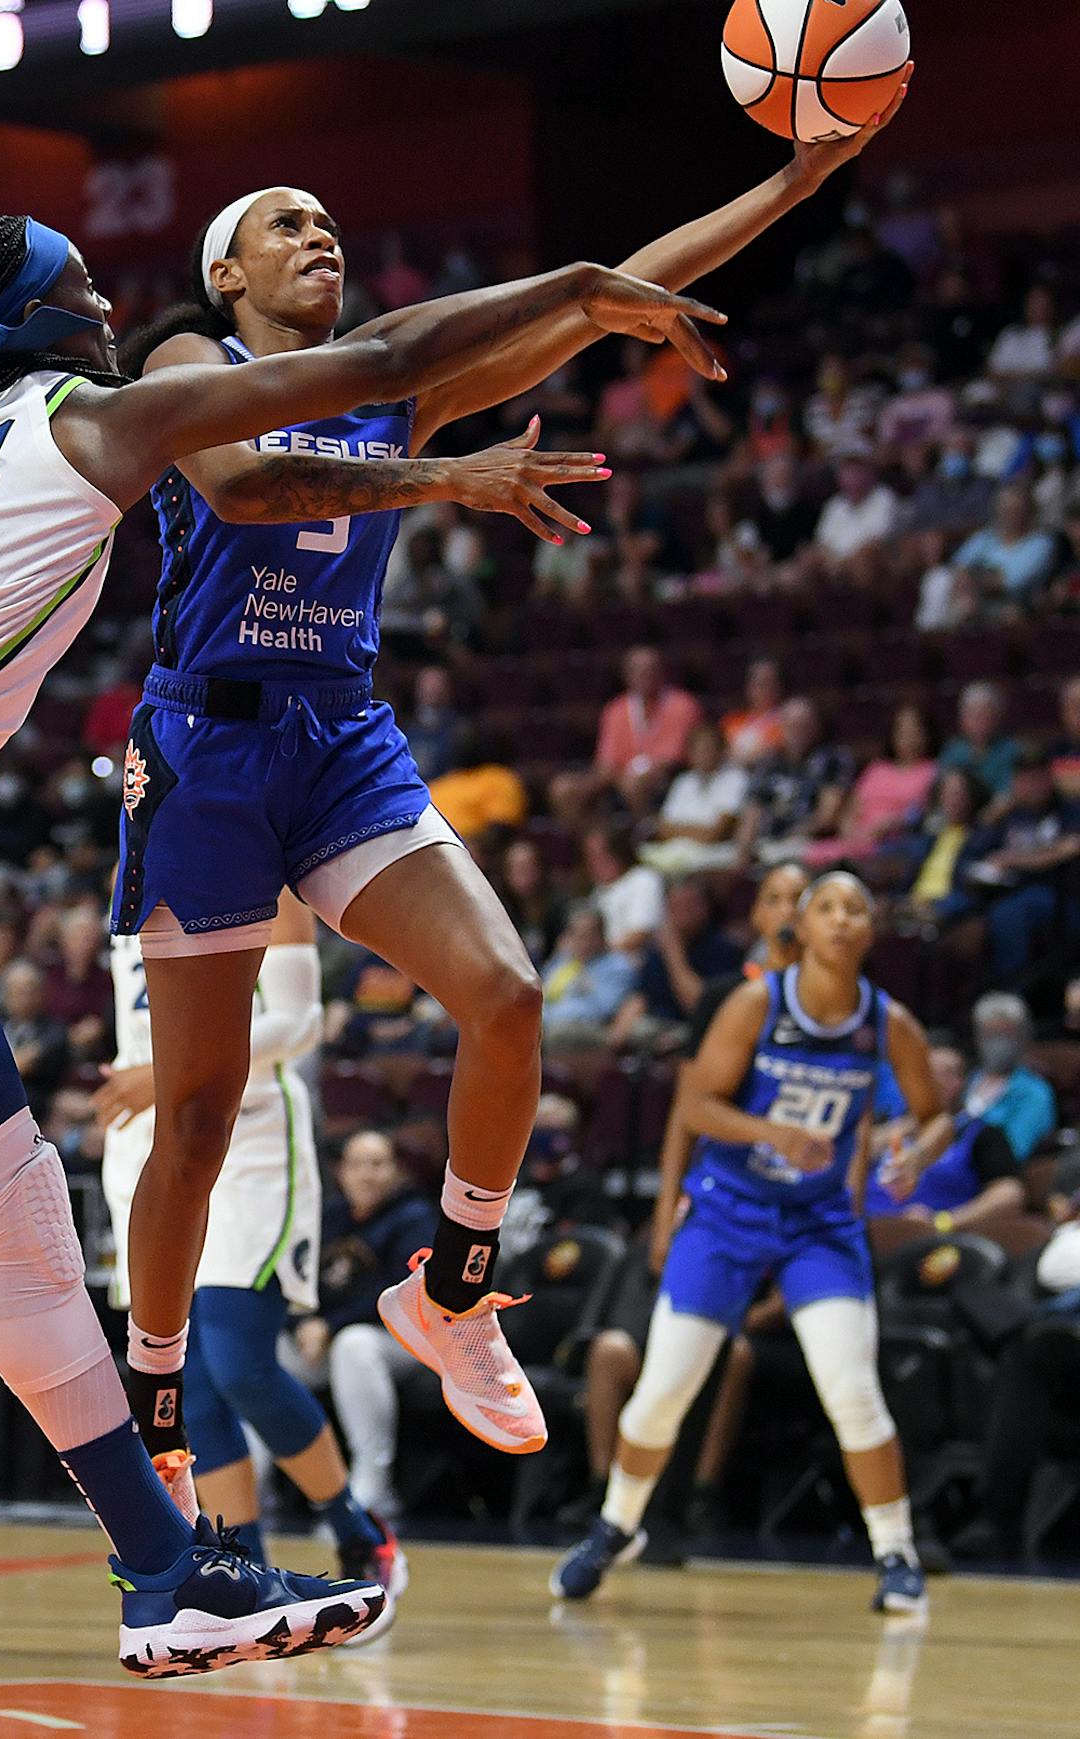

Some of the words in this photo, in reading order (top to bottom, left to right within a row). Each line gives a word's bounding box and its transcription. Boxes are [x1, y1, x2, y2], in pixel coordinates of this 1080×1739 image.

[83, 158, 176, 234] 23
[247, 430, 404, 460] EESUSK
[251, 565, 297, 594] Yale
[237, 620, 323, 652] Health
[769, 1084, 851, 1140] 20
